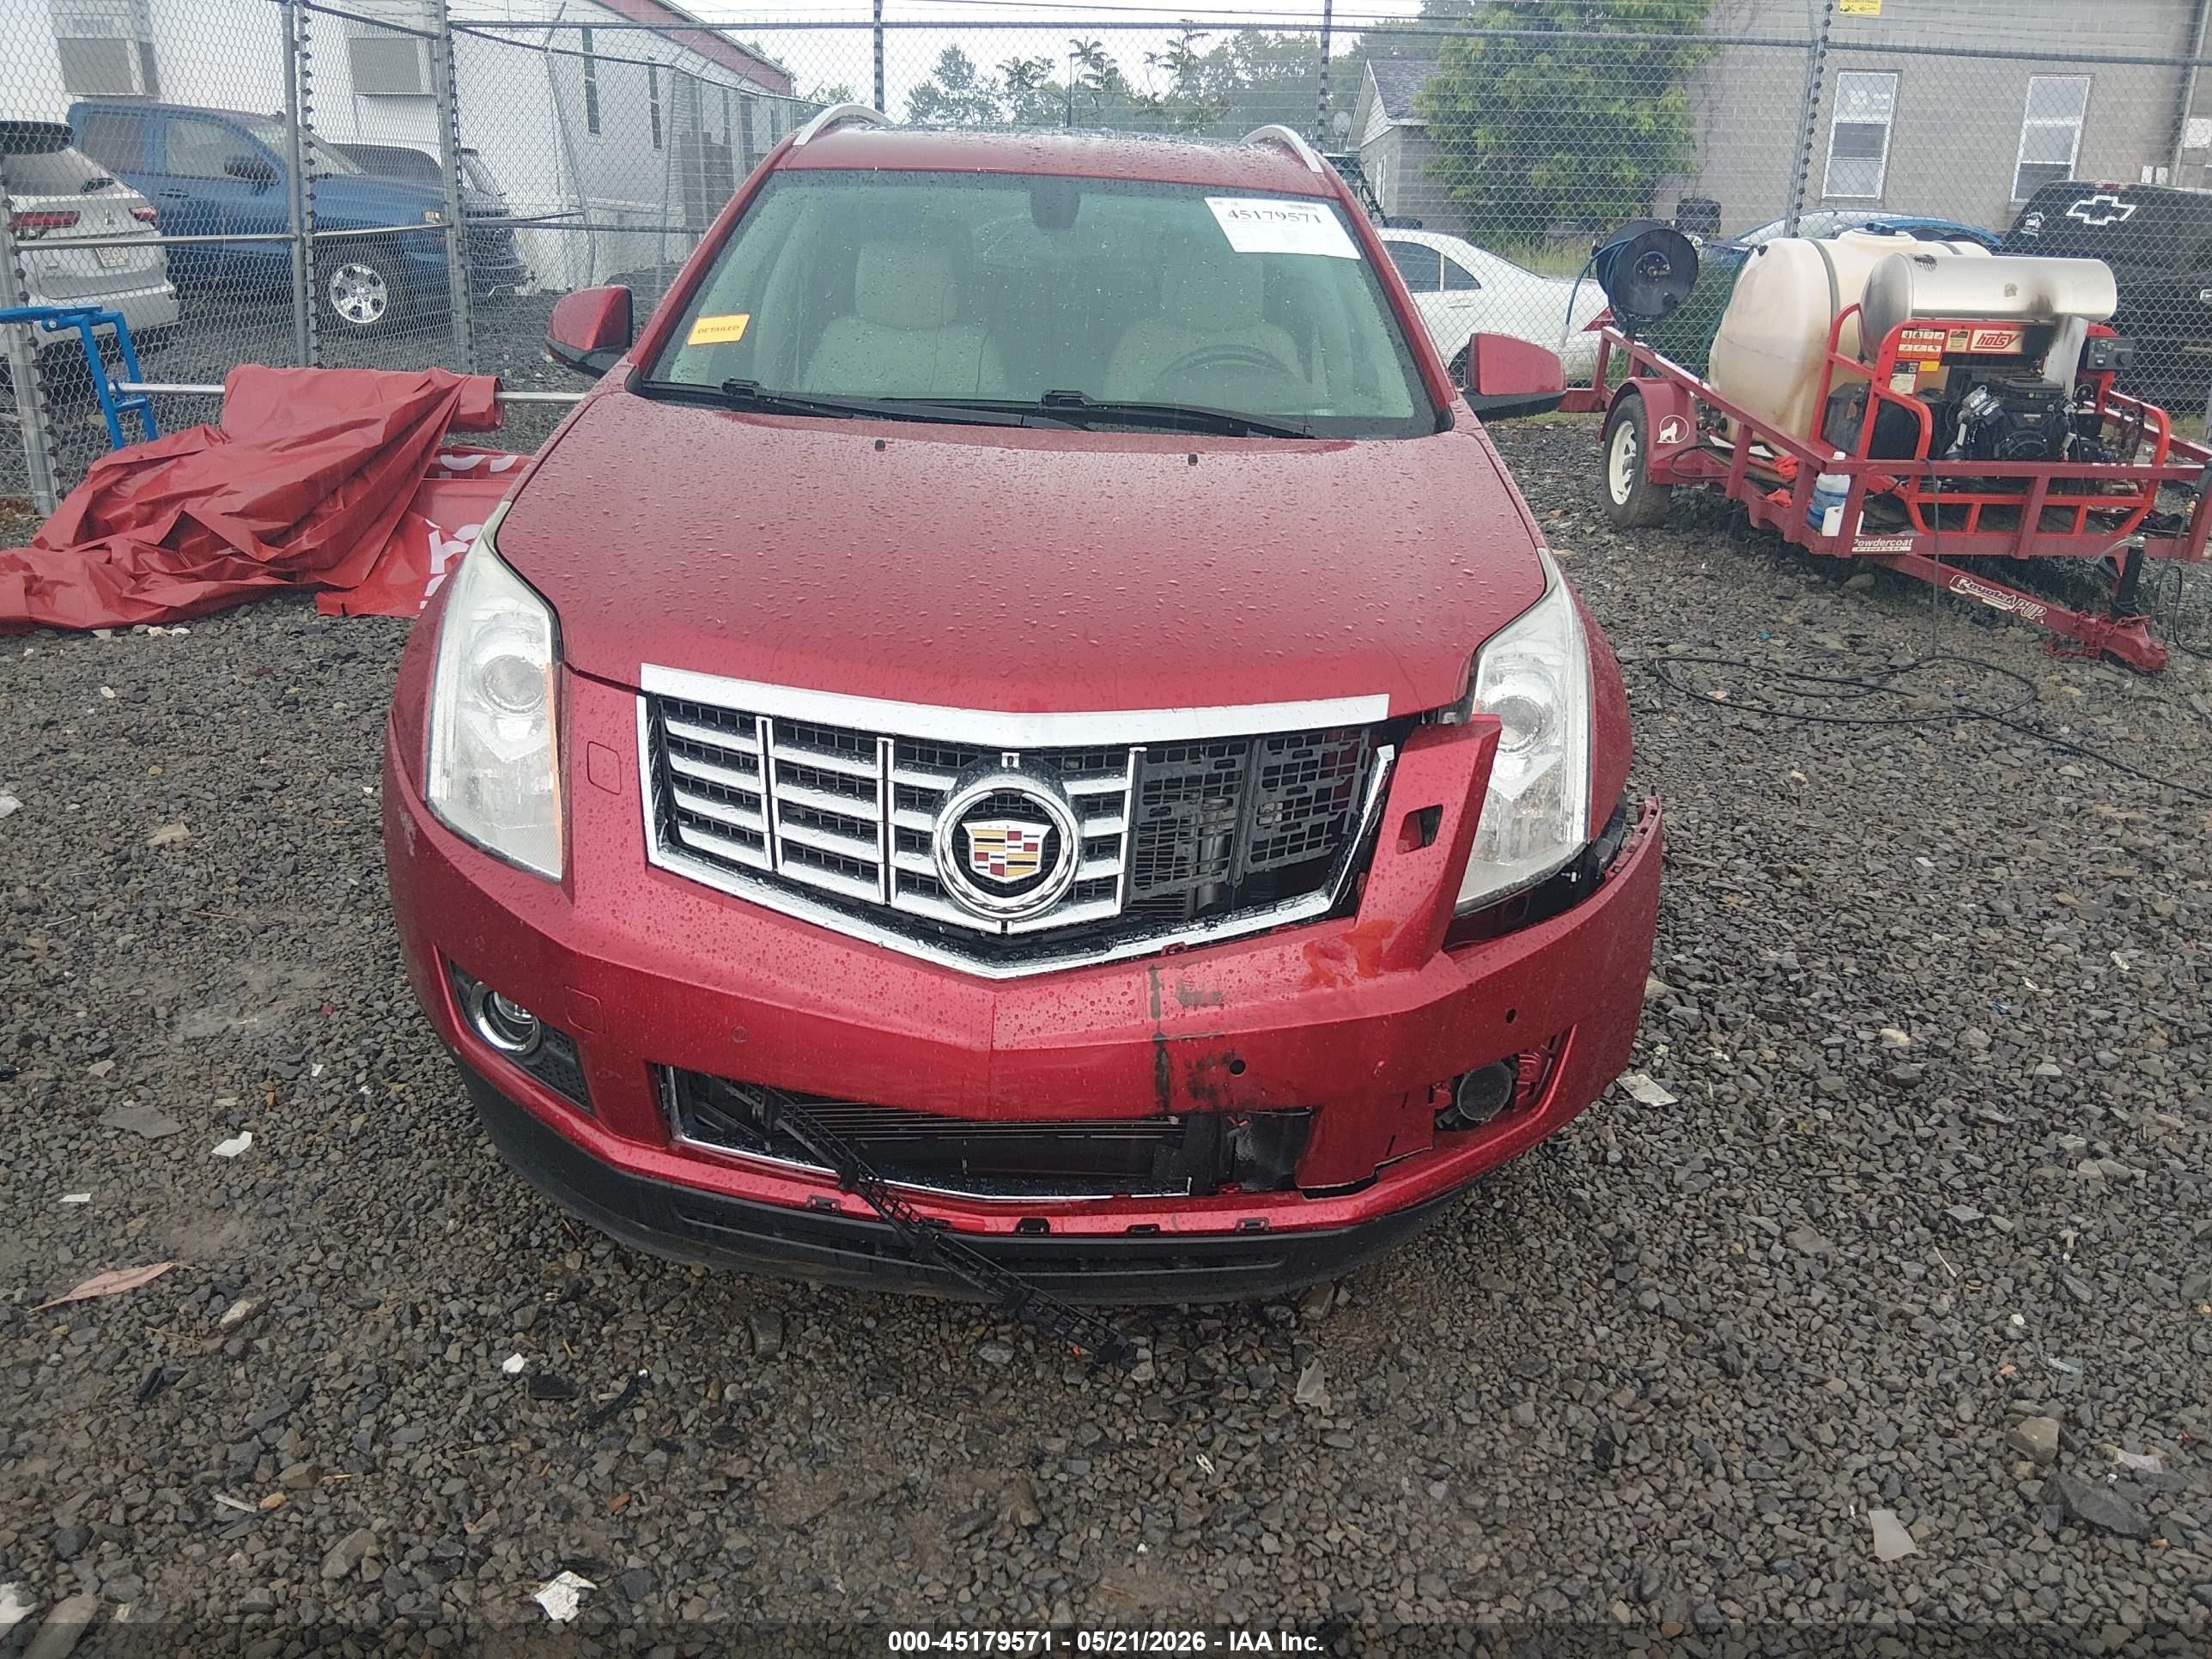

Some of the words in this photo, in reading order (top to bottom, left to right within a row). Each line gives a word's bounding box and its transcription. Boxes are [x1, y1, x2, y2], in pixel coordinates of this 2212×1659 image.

[1228, 210, 1322, 224] 45179571
[697, 325, 739, 334] DETAILED
[1853, 538, 1913, 547] Powdercoat
